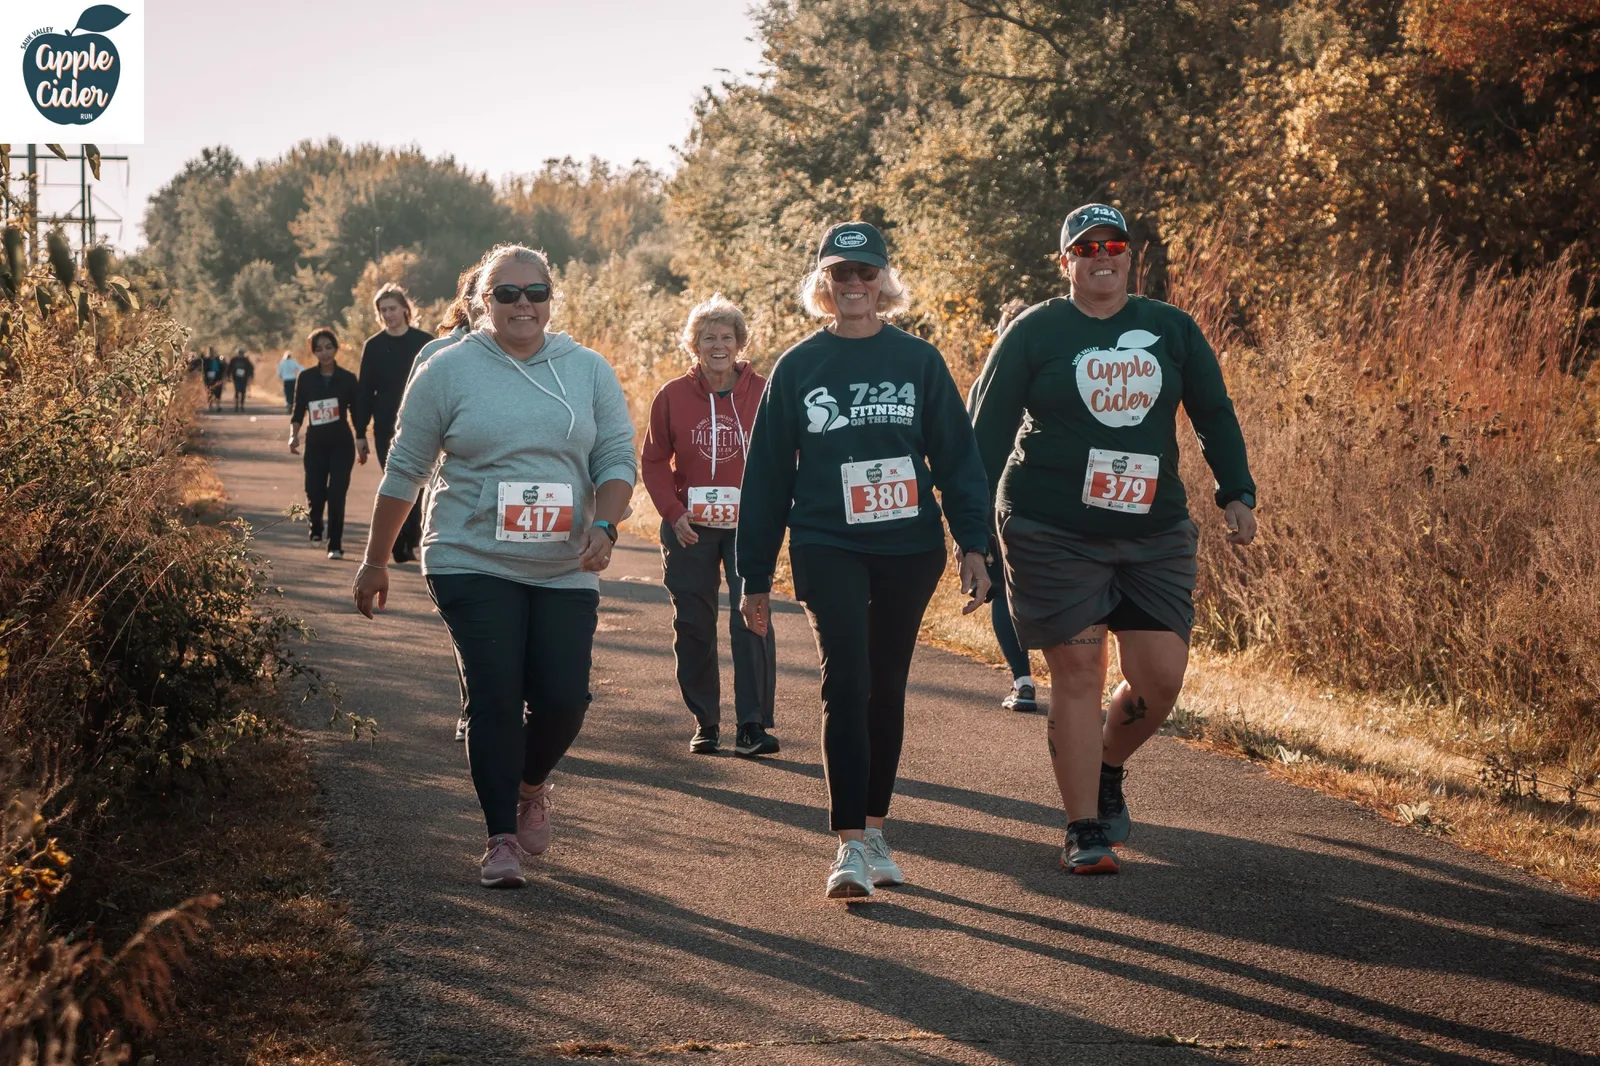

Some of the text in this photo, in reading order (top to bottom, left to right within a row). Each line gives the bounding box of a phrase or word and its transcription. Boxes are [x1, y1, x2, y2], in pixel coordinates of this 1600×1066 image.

[1081, 346, 1100, 355] VALLEY
[1087, 355, 1156, 386] Apple
[849, 381, 916, 406] 7:24
[1091, 386, 1153, 413] Cider
[850, 404, 915, 418] FITNESS
[850, 415, 913, 427] ON THE ROCK
[863, 482, 908, 512] 380
[1102, 474, 1147, 503] 379
[516, 506, 561, 532] 417
[701, 504, 736, 522] 433
